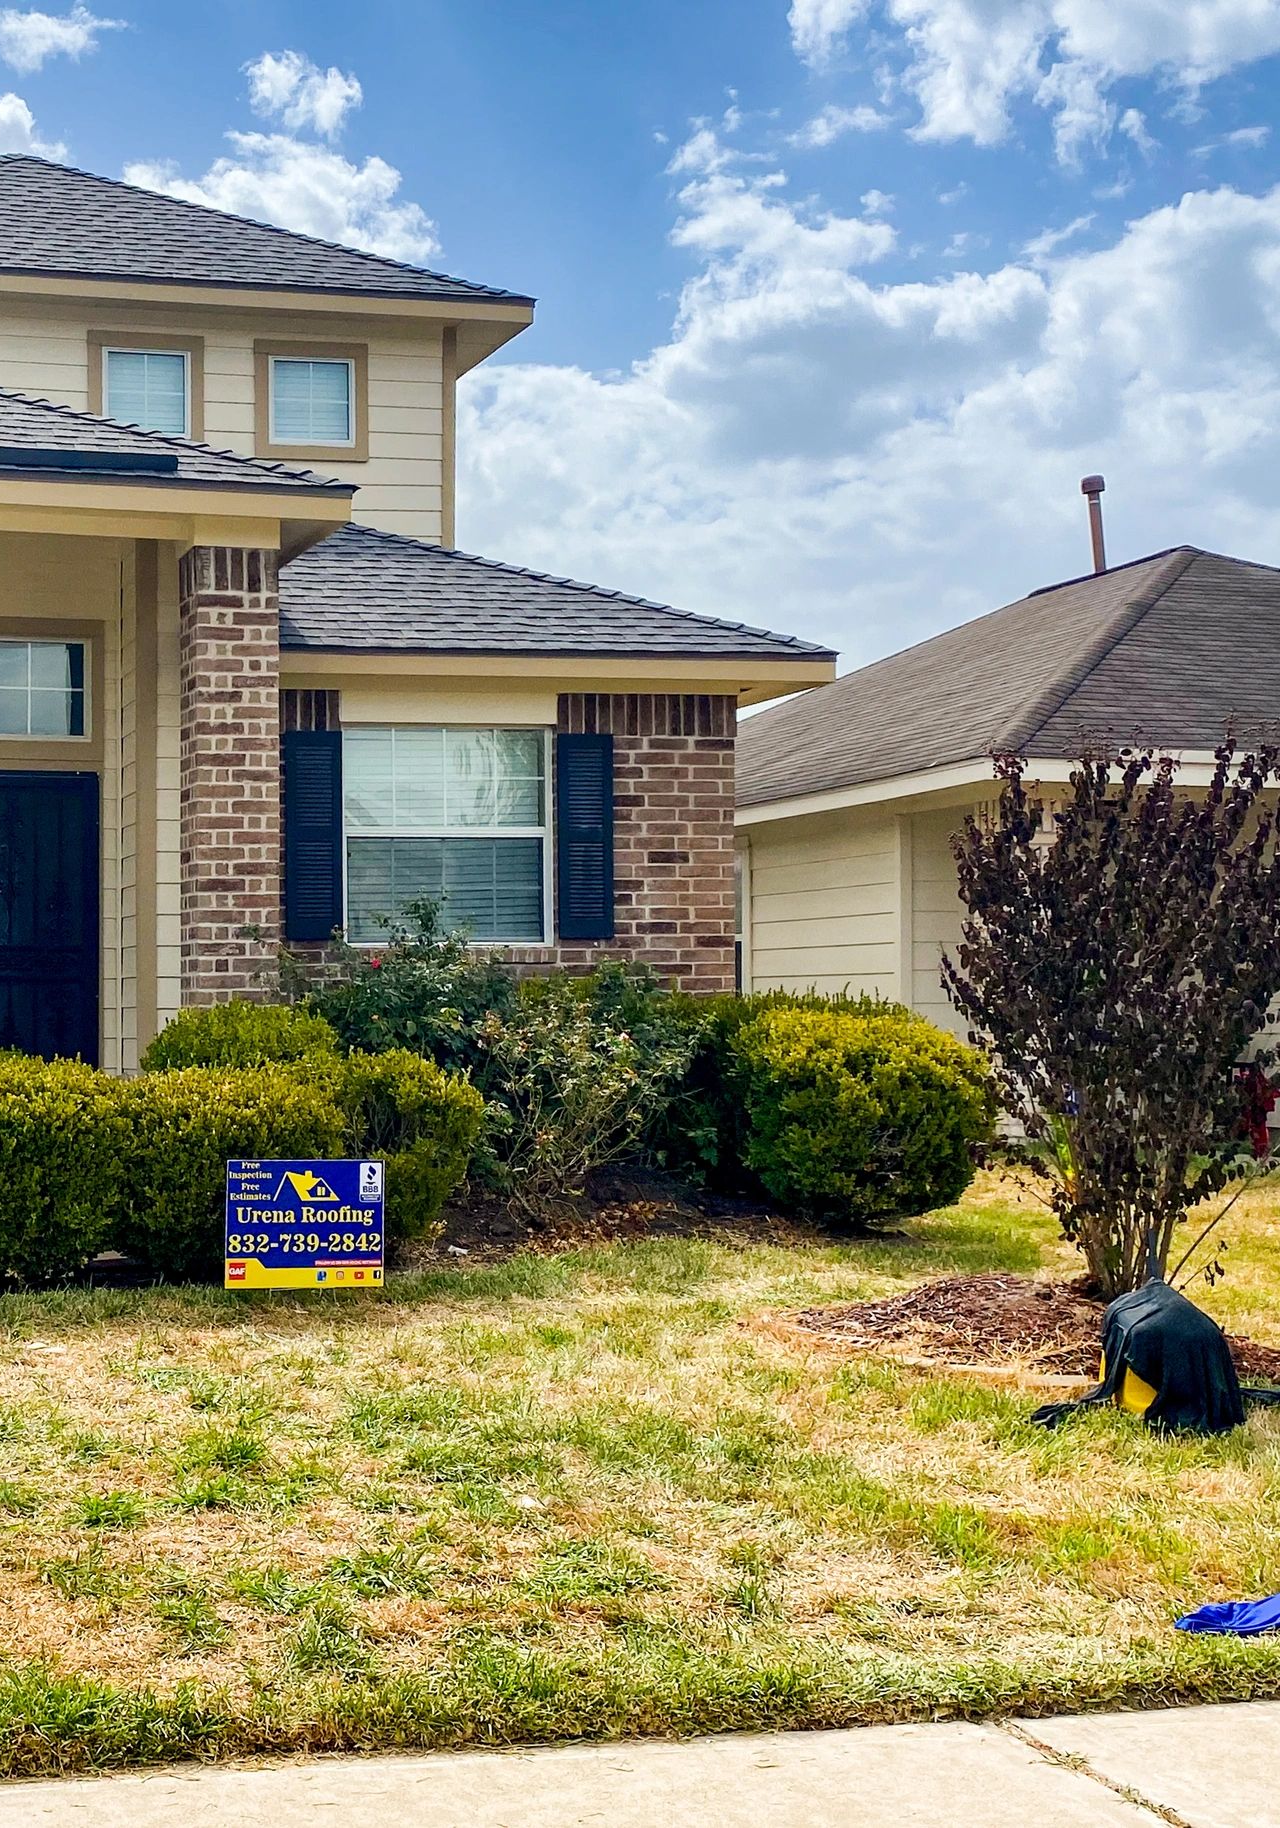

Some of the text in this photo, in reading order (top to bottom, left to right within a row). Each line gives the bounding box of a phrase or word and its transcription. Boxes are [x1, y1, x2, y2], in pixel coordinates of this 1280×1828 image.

[241, 1161, 260, 1169] Free
[228, 1171, 272, 1180] Inspection
[241, 1183, 260, 1191] Free
[230, 1192, 271, 1201] Estimates
[236, 1205, 375, 1225] Urena Roofing
[228, 1233, 381, 1253] 832-739-2842
[229, 1267, 246, 1276] GAF
